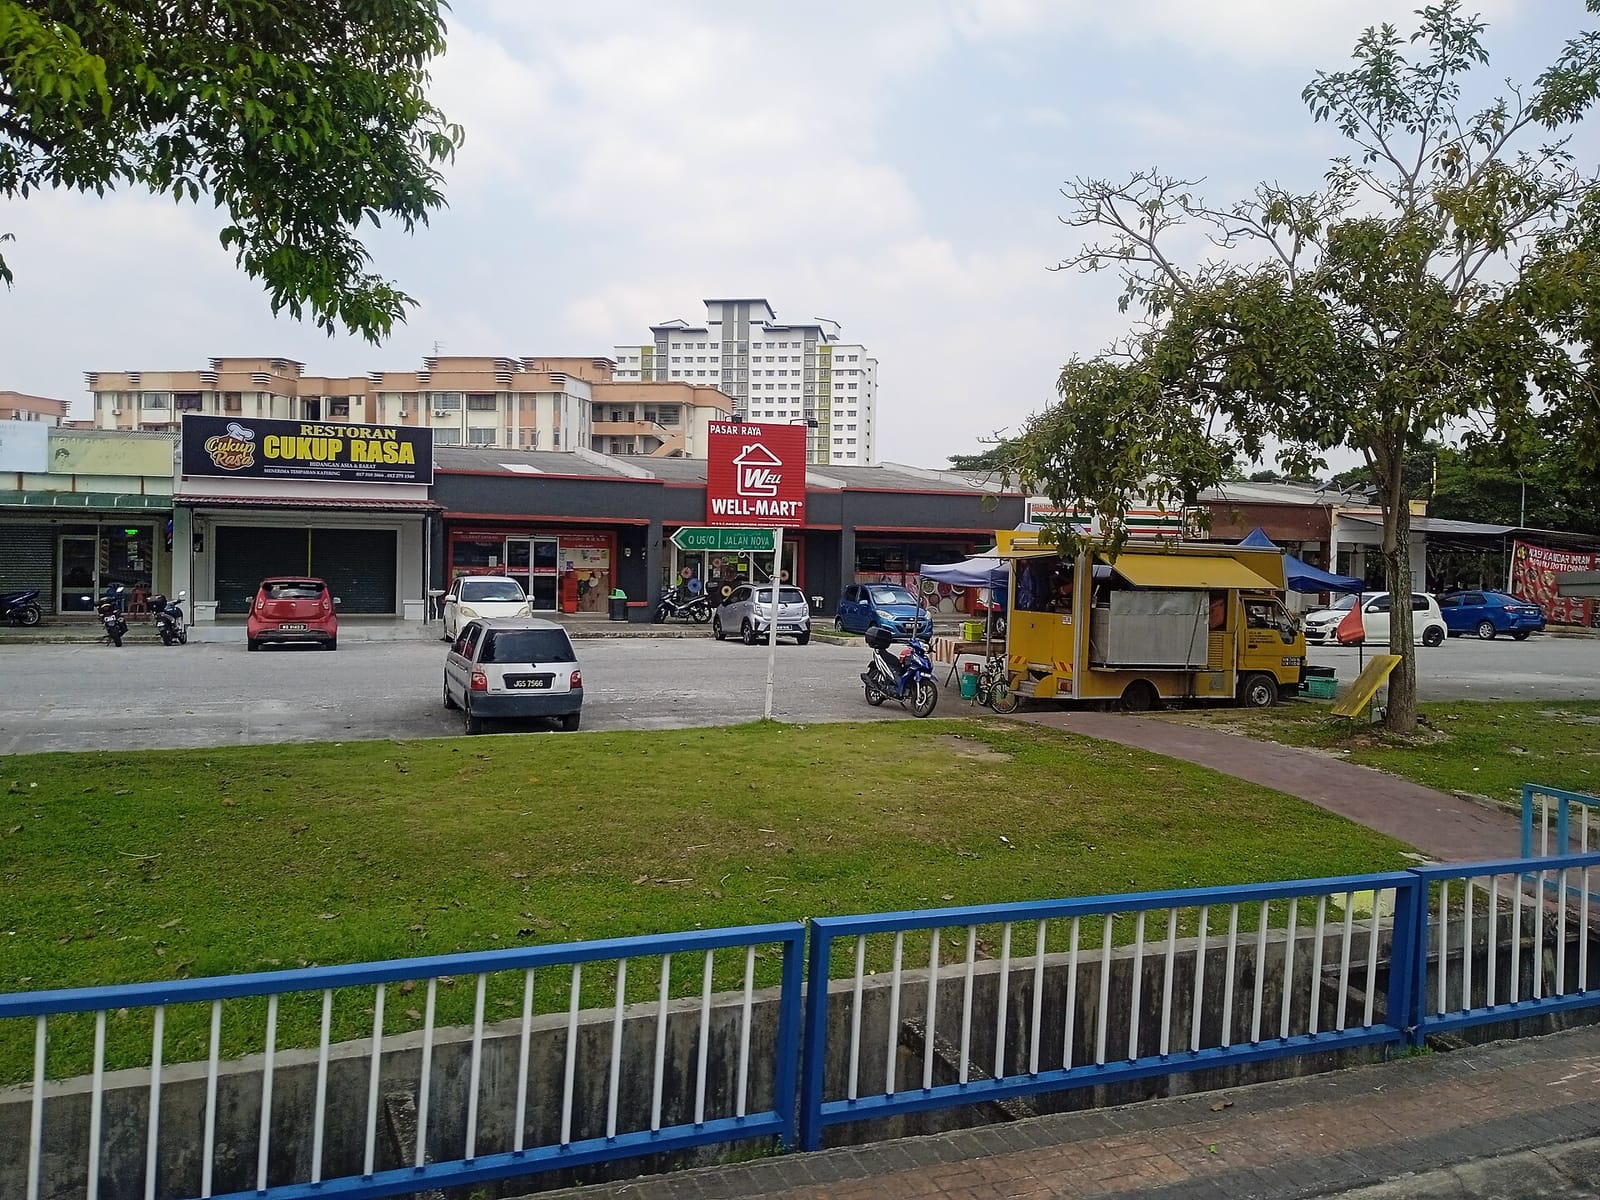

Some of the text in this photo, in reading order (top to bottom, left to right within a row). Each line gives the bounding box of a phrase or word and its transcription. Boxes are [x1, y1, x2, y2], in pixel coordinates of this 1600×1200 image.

[300, 424, 397, 440] RESTORAN
[710, 425, 762, 436] PASAR RAYA
[206, 436, 255, 456] Cukup
[263, 435, 416, 464] CUKUP RASA
[214, 451, 253, 467] Rasa
[723, 536, 748, 546] JALAN
[750, 536, 770, 546] NOVA
[513, 680, 527, 688] JGS
